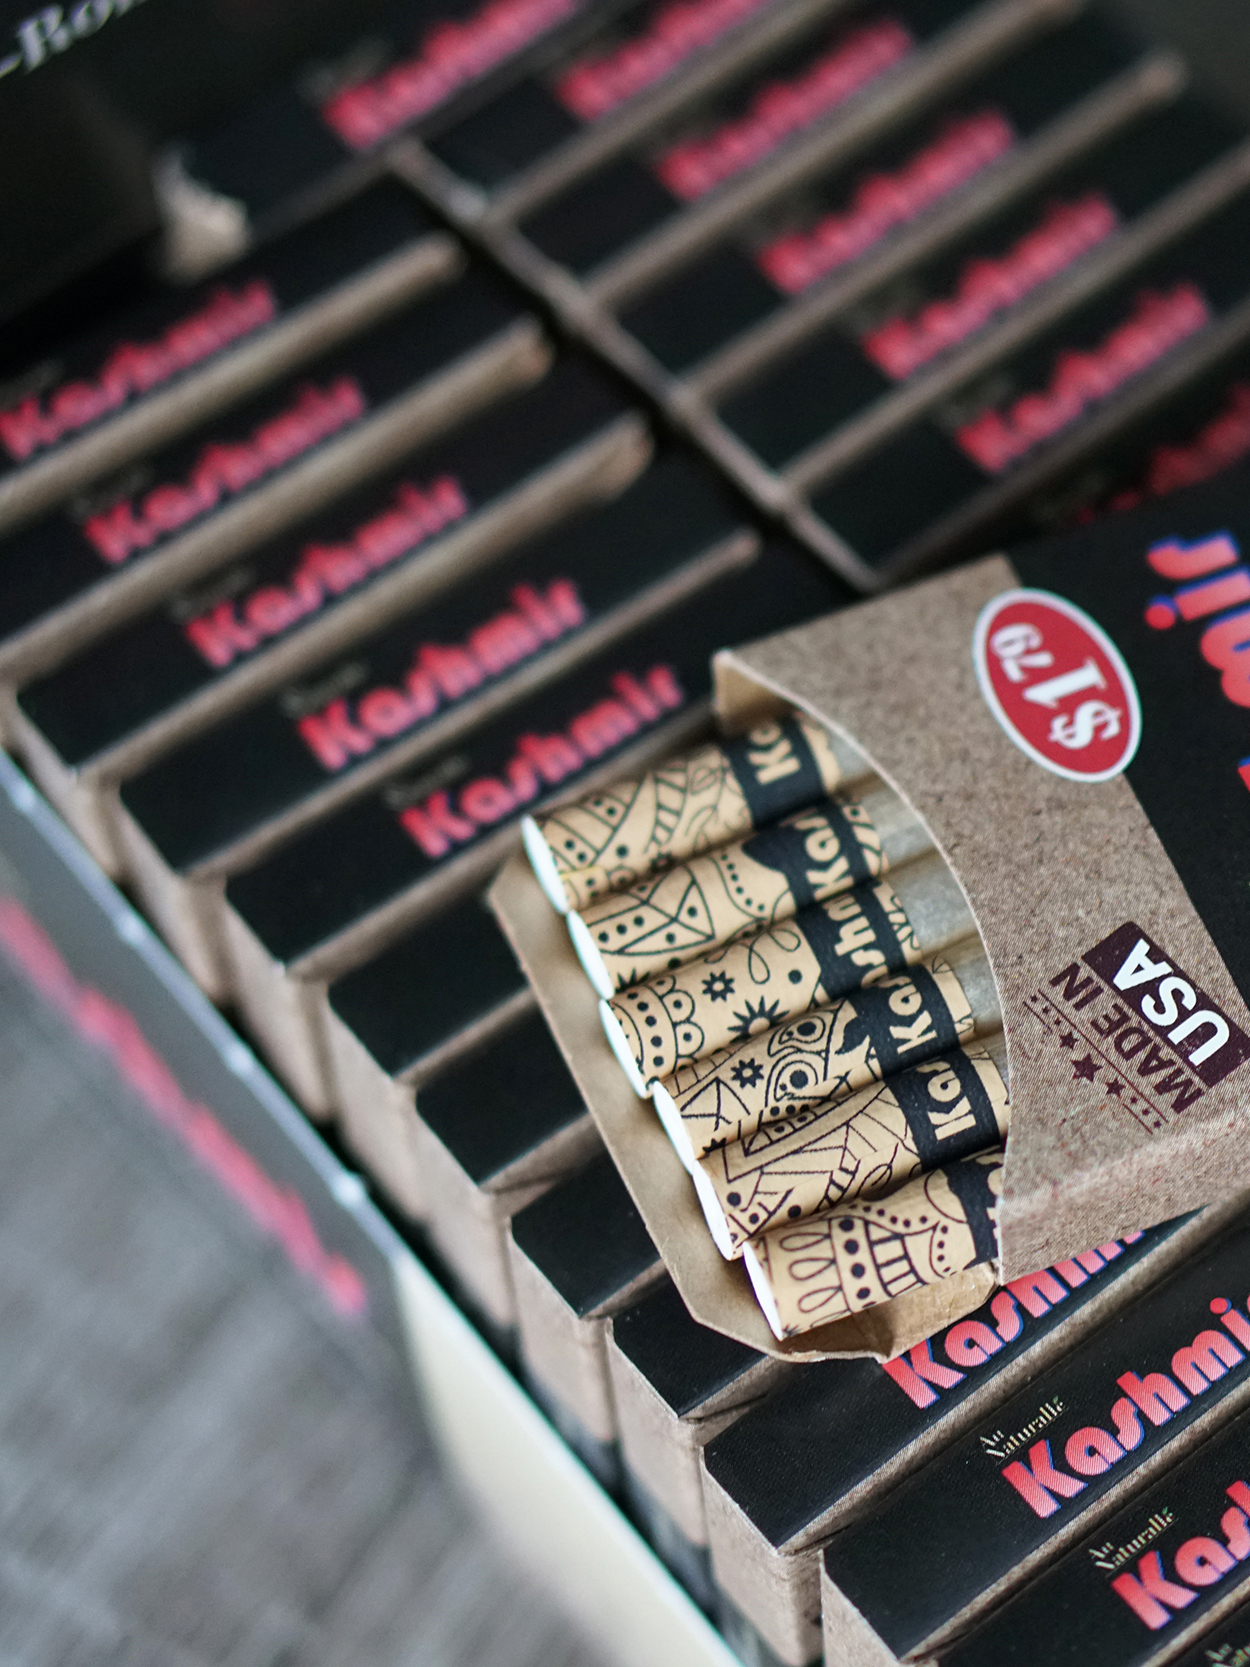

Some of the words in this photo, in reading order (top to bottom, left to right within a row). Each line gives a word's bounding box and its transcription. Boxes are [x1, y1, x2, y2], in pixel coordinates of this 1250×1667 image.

[298, 578, 584, 769] Kashmir
[400, 665, 681, 857] Kashmir
[1049, 961, 1104, 1012] IN
[1090, 1003, 1205, 1115] MADE
[1112, 938, 1230, 1067] USA
[882, 1231, 1146, 1409] Kashm
